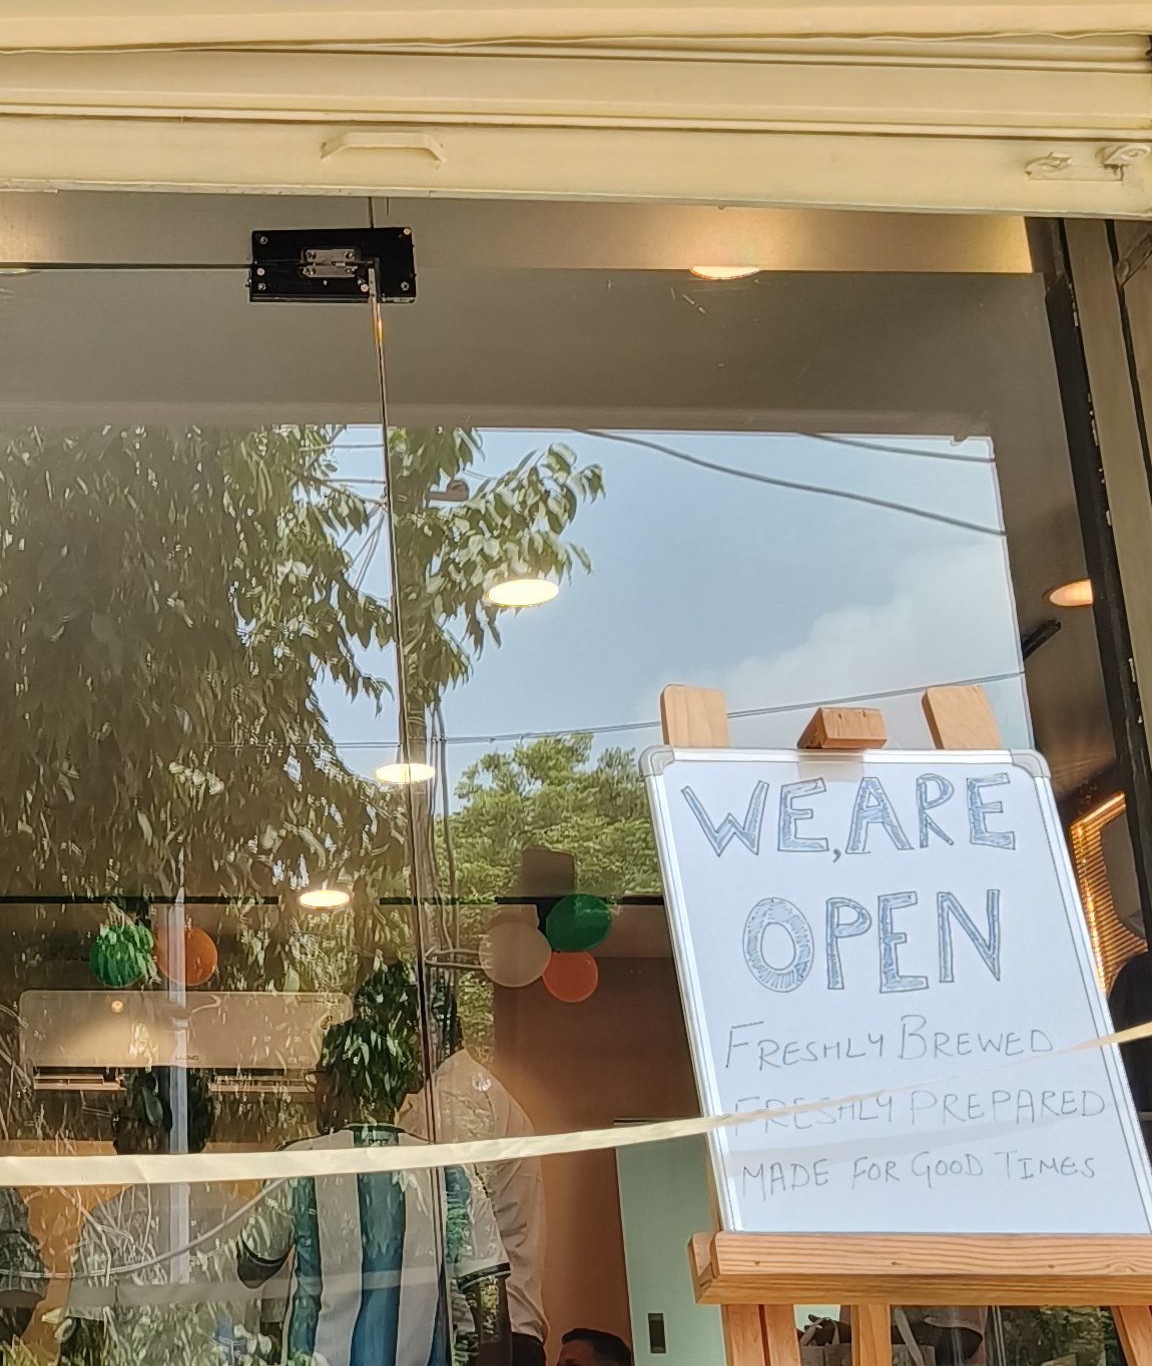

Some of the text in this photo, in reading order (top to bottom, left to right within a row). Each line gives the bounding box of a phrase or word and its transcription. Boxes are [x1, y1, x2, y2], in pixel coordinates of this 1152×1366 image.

[741, 888, 1001, 994] OPEN
[724, 1014, 1054, 1071] FRESHLY BREWED
[910, 1089, 1107, 1126] PREPARED
[741, 1148, 1096, 1202] MADE FOR GOOD TIMES
